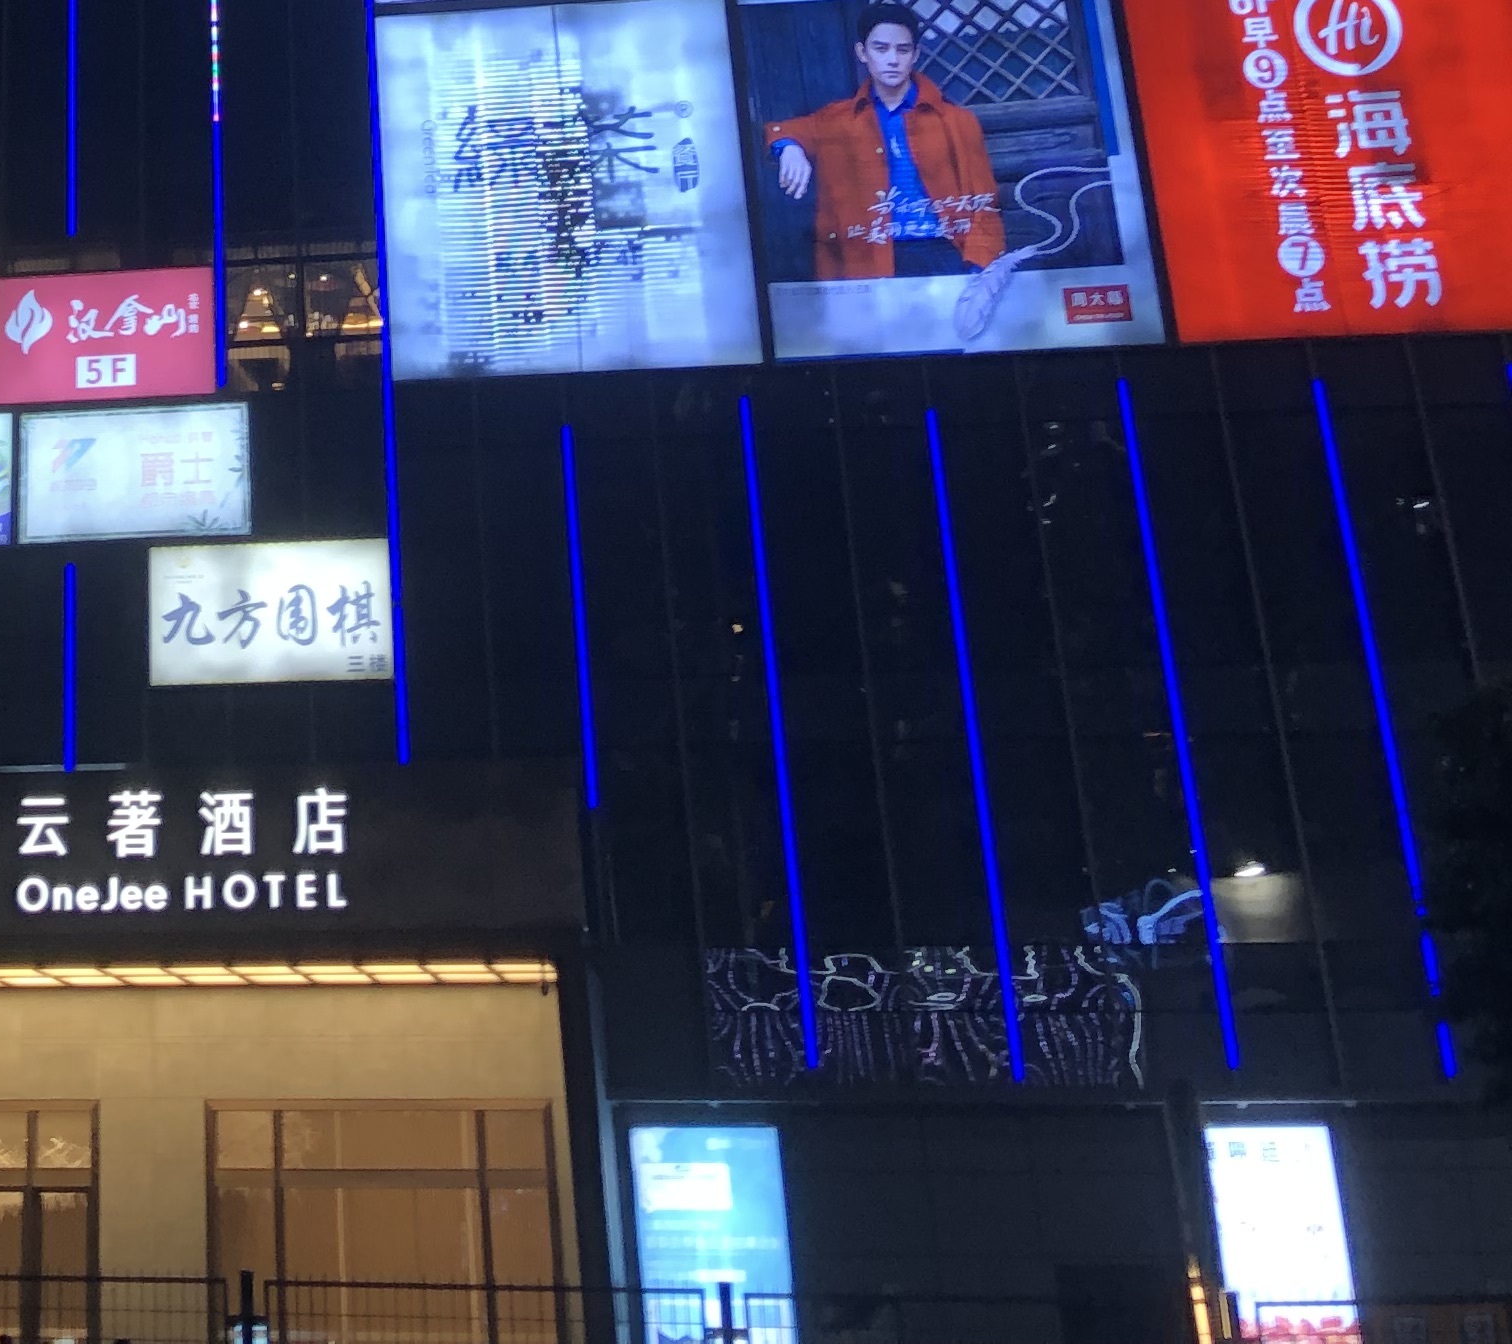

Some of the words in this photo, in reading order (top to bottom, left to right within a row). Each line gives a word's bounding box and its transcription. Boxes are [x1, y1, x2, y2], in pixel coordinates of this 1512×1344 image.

[1325, 89, 1443, 309] 海底捞
[66, 293, 186, 344] 汉拿山
[85, 357, 126, 384] 5F
[162, 580, 382, 650] 九方围棋
[16, 787, 349, 858] 云著酒店
[16, 876, 169, 913] OneJee
[184, 872, 349, 910] HOTEL
